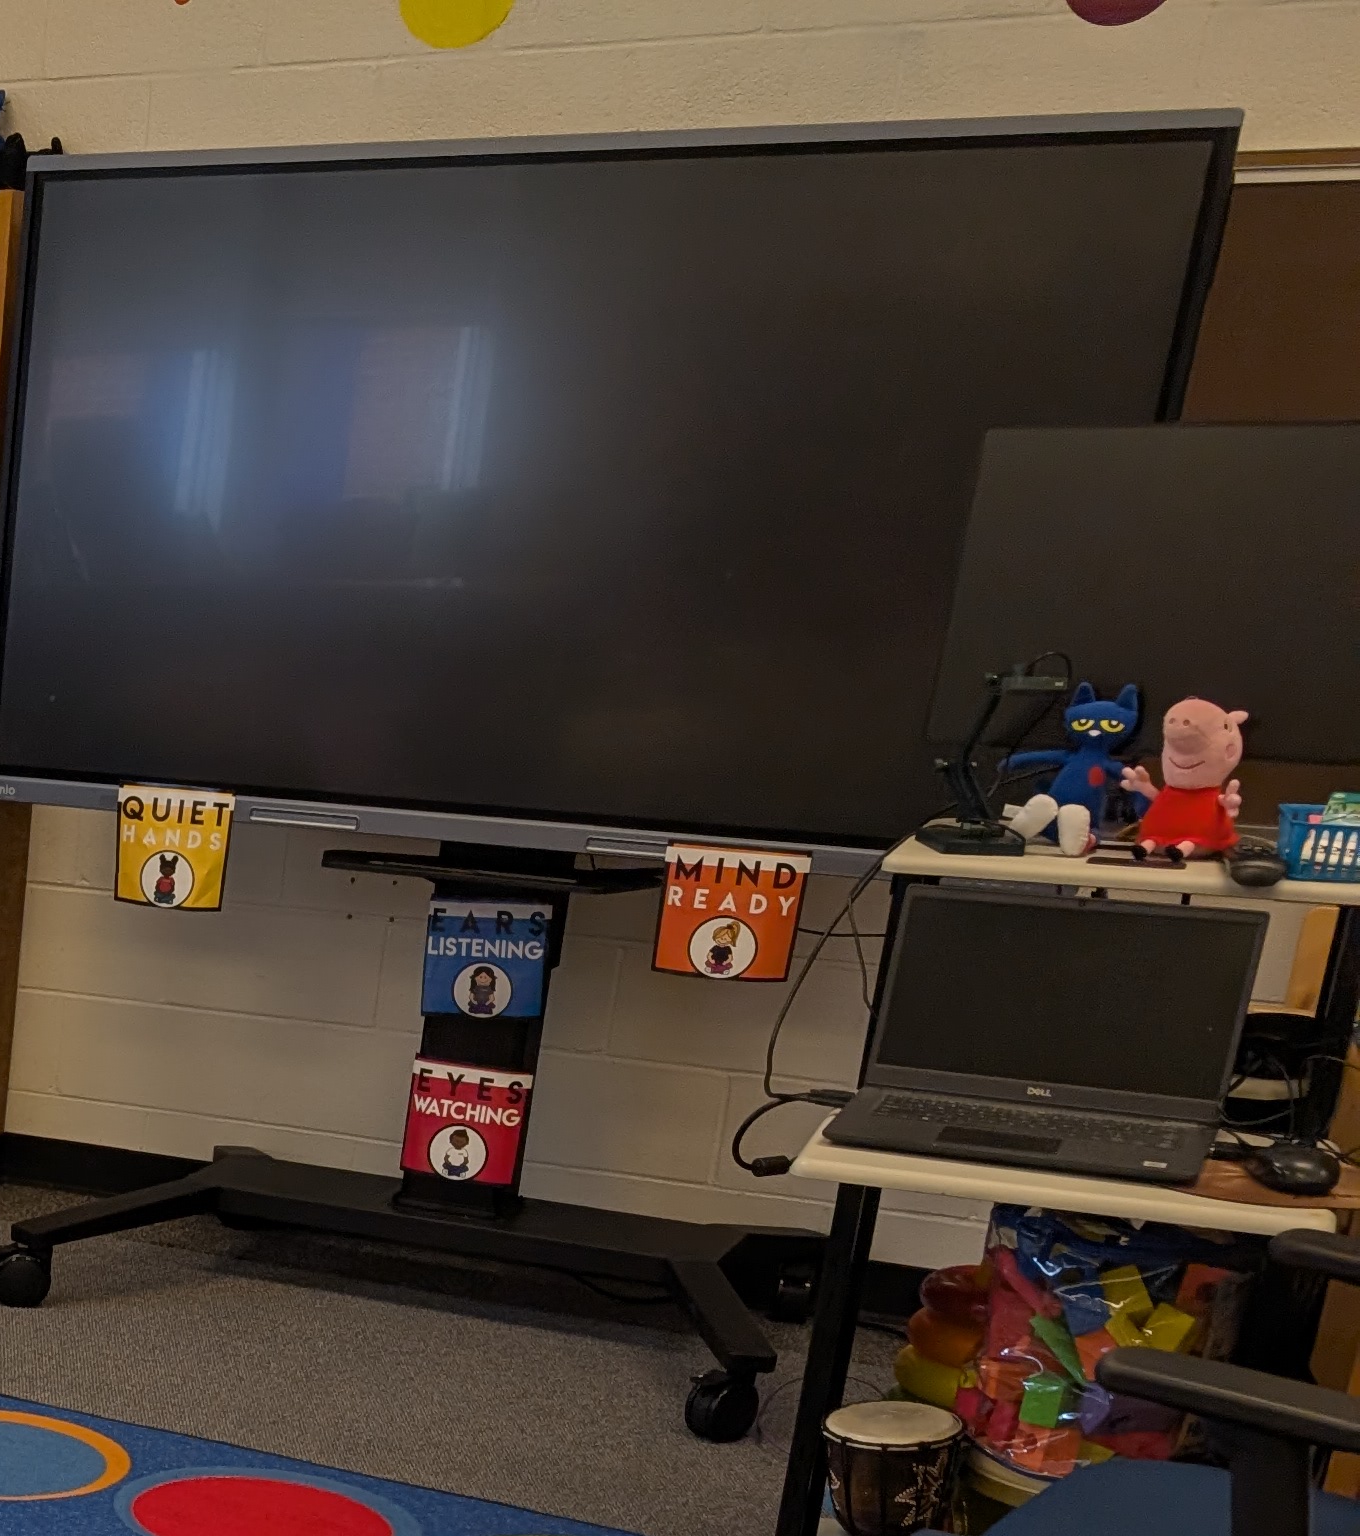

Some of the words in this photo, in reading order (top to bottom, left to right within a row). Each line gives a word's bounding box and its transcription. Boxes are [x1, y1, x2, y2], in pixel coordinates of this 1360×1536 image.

[122, 795, 230, 827] QUIET
[123, 824, 222, 851] HANDS
[674, 854, 797, 889] MIND
[667, 885, 796, 917] READY
[431, 907, 546, 936] EARS
[427, 936, 544, 960] LISTENING
[416, 1067, 525, 1104] EYES
[1027, 1087, 1052, 1097] DELL
[413, 1093, 521, 1127] WATCHING
